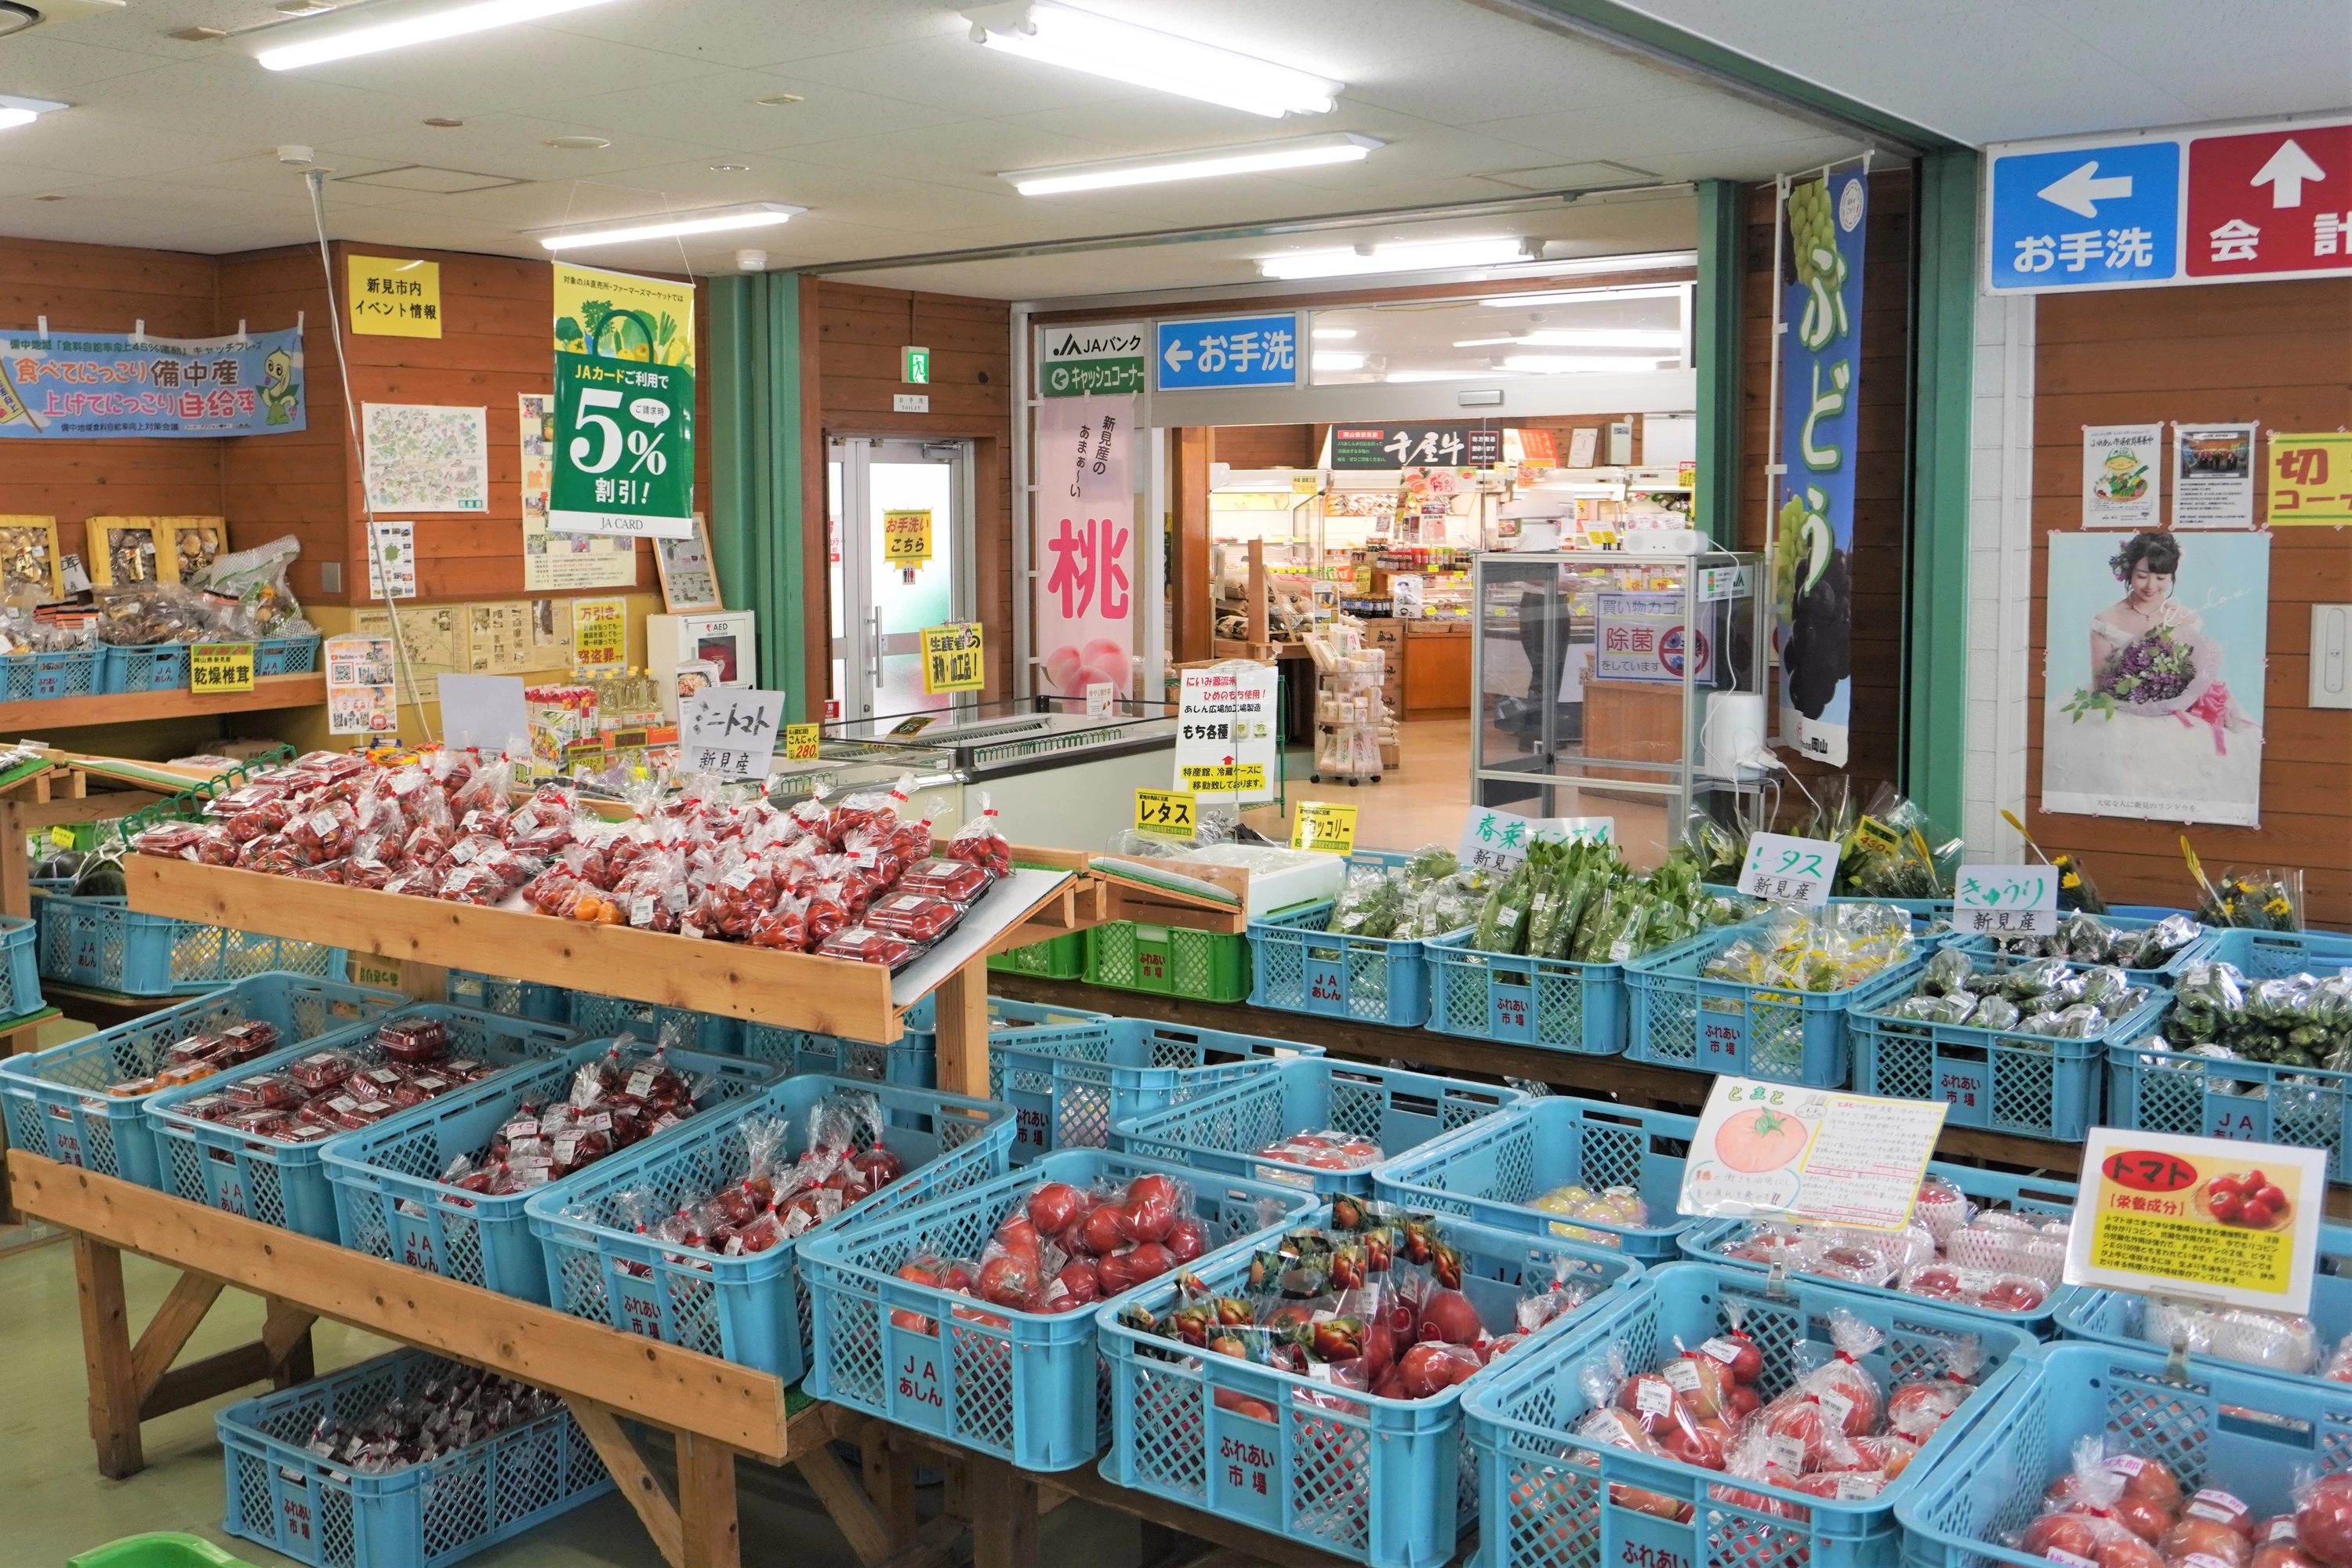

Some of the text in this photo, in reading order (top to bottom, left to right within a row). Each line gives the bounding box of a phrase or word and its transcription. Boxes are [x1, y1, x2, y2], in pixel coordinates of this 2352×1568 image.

[2209, 211, 2352, 262] 会計
[2013, 227, 2153, 272] お手洗
[367, 278, 421, 296] 新見市内
[355, 299, 437, 320] イベント情報
[1083, 335, 1142, 353] JAバンク
[1198, 330, 1294, 372] お手洗
[15, 358, 238, 387] 食べてにっこり備中産
[575, 365, 669, 389] JAカードご利用で
[1072, 365, 1144, 390] キャッシュコーナー
[42, 389, 255, 419] 上げてにっこり自給率
[635, 405, 665, 416] ご請求時
[570, 387, 666, 476] 5%
[1093, 416, 1116, 475] 新見産の
[1384, 431, 1465, 466] 千屋牛
[600, 517, 643, 531] JA CARD
[885, 517, 929, 534] お手洗い
[891, 537, 924, 553] こちら
[1047, 517, 1129, 619] 桃
[1602, 599, 1685, 615] 買い物カゴの
[930, 634, 980, 652] 生産者の
[1607, 627, 1654, 652] 除菌
[194, 666, 249, 685] 乾燥椎茸
[1602, 661, 1661, 672] をしています
[1186, 677, 1236, 688] にいみ源流米
[788, 735, 817, 745] こんにゃく
[1183, 724, 1229, 740] もち各種
[796, 745, 815, 758] 280
[699, 750, 749, 775] 新見産
[1183, 765, 1261, 777] 特産館、冷蔵ケースに
[1142, 800, 1190, 825] レタス
[1473, 849, 1524, 873] 新見
[1754, 876, 1809, 900] 新見産
[1961, 877, 2044, 906] きゅうり
[1973, 911, 2037, 932] 新見産
[80, 942, 95, 953] JA
[1140, 951, 1166, 966] ふれあい
[1143, 965, 1162, 978] 市場
[1314, 972, 1338, 986] JA
[1312, 985, 1341, 1001] あしん
[1497, 996, 1529, 1013] ふれあい
[1501, 1013, 1525, 1027] 市場
[1704, 1024, 1741, 1041] ふれあい
[1709, 1040, 1736, 1057] 市場
[1940, 1073, 1981, 1092] ふれあい
[1728, 1086, 1784, 1105] とまと
[1947, 1091, 1975, 1108] 市場
[507, 1123, 535, 1134] アイコ
[590, 1115, 608, 1126] イコ
[2219, 1111, 2254, 1130] JA
[558, 1131, 584, 1139] アイコ
[2113, 1155, 2190, 1186] トマト
[221, 1179, 242, 1198] JA
[408, 1231, 433, 1251] JA
[406, 1250, 439, 1272] あしん
[624, 1294, 662, 1319] ふれあい
[903, 1354, 937, 1382] JA
[898, 1377, 943, 1408] あしん
[1220, 1436, 1275, 1468] ふれあい
[1229, 1464, 1268, 1496] 市場
[283, 1497, 312, 1520] ふれあい
